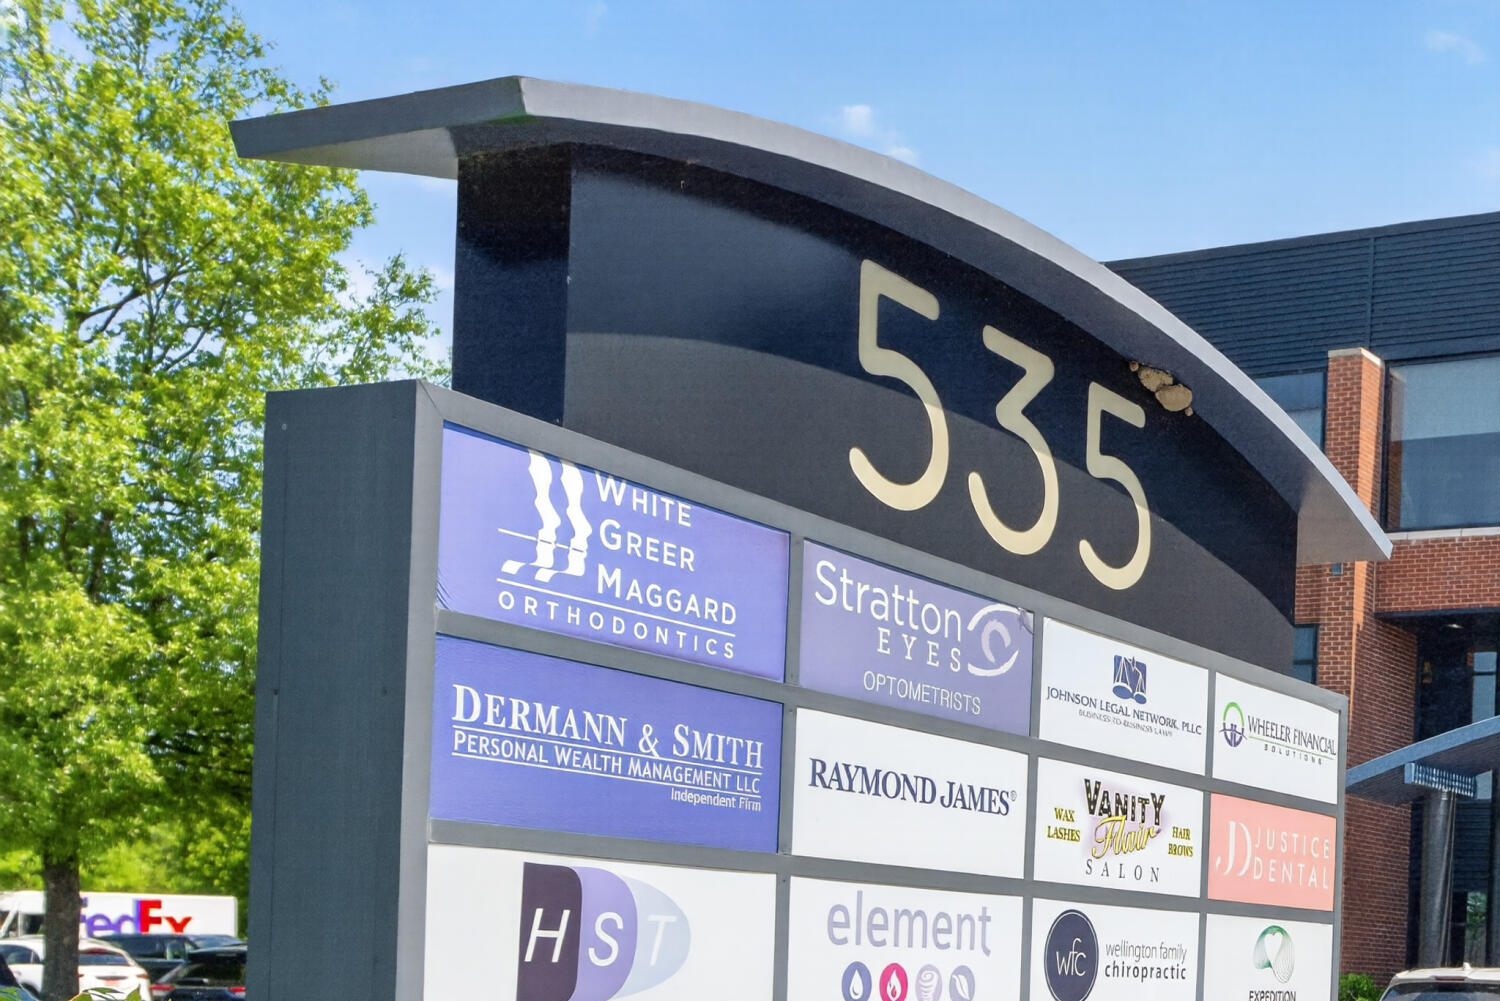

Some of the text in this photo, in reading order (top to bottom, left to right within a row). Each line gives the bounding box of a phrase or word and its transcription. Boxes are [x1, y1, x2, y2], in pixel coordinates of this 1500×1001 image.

[849, 259, 1152, 590] 535
[594, 470, 692, 527] WHITE
[599, 519, 695, 572] GREER
[597, 563, 736, 625] MAGGARD
[814, 559, 962, 642] Stratton
[498, 591, 735, 659] ORTHODONTICS
[876, 626, 961, 672] EYES
[863, 670, 981, 716] OPTOMETRISTS
[1046, 686, 1097, 709] JOHNSON
[1099, 701, 1131, 718] LEGAL
[1181, 721, 1203, 735] PLLC
[452, 683, 764, 769] DERMANN & SMITH
[1247, 715, 1337, 756] WHEELER FINANCIAL
[453, 729, 761, 794] PERSONAL WEALTH MANAGEMENT LLC
[1264, 743, 1322, 765] SOLUTIONS
[671, 787, 762, 812] Independent Firm
[808, 757, 937, 804] RAYMOND
[1084, 778, 1166, 826] VANITY
[1047, 825, 1081, 842] LASHES
[1054, 807, 1076, 823] WAX
[1171, 826, 1191, 841] HAIR
[1167, 843, 1194, 858] BROWS
[1254, 825, 1330, 859] JUSTICE
[1085, 858, 1160, 883] SALON
[1253, 856, 1330, 889] DENTAL
[78, 897, 193, 936] edEx
[827, 890, 992, 958] element
[1104, 960, 1187, 983] chiropractic
[1105, 939, 1188, 965] wellington family
